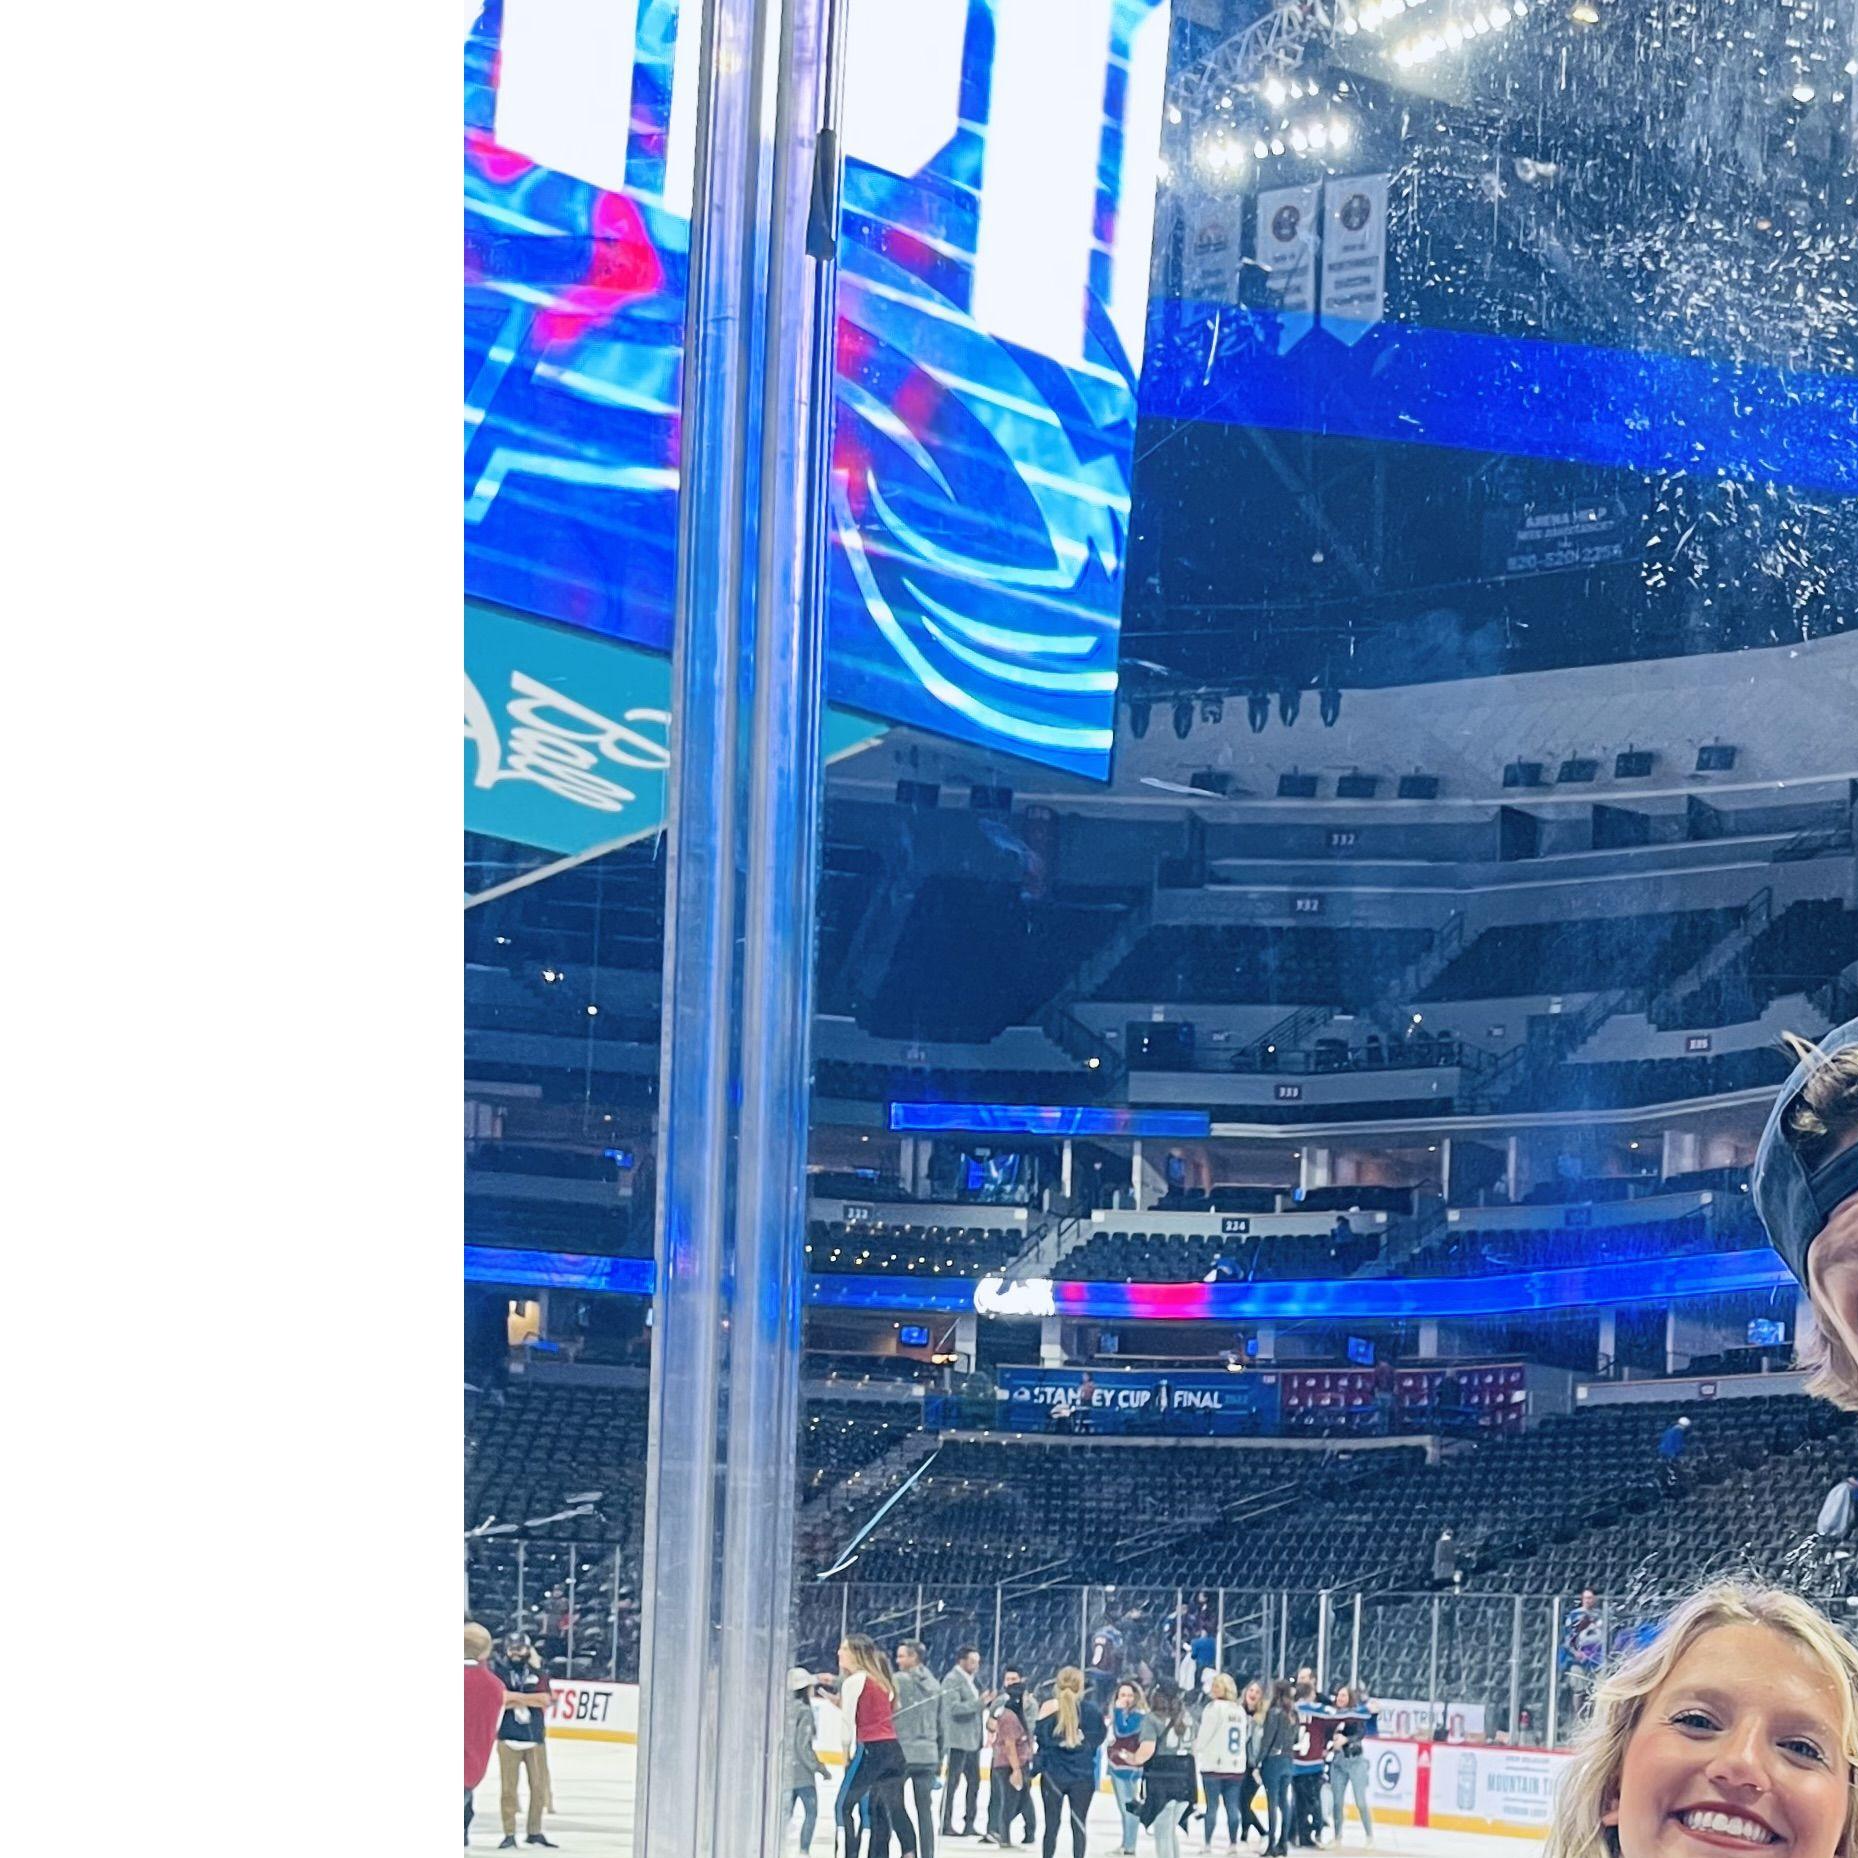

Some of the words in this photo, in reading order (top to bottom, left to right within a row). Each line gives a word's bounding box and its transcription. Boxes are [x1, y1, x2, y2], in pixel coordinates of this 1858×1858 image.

[1033, 1386, 1116, 1407] STANEY
[1117, 1389, 1151, 1409] CUP
[1173, 1390, 1223, 1409] FINAL
[1228, 1726, 1241, 1756] 8
[1487, 1773, 1539, 1795] MOUNTAIN
